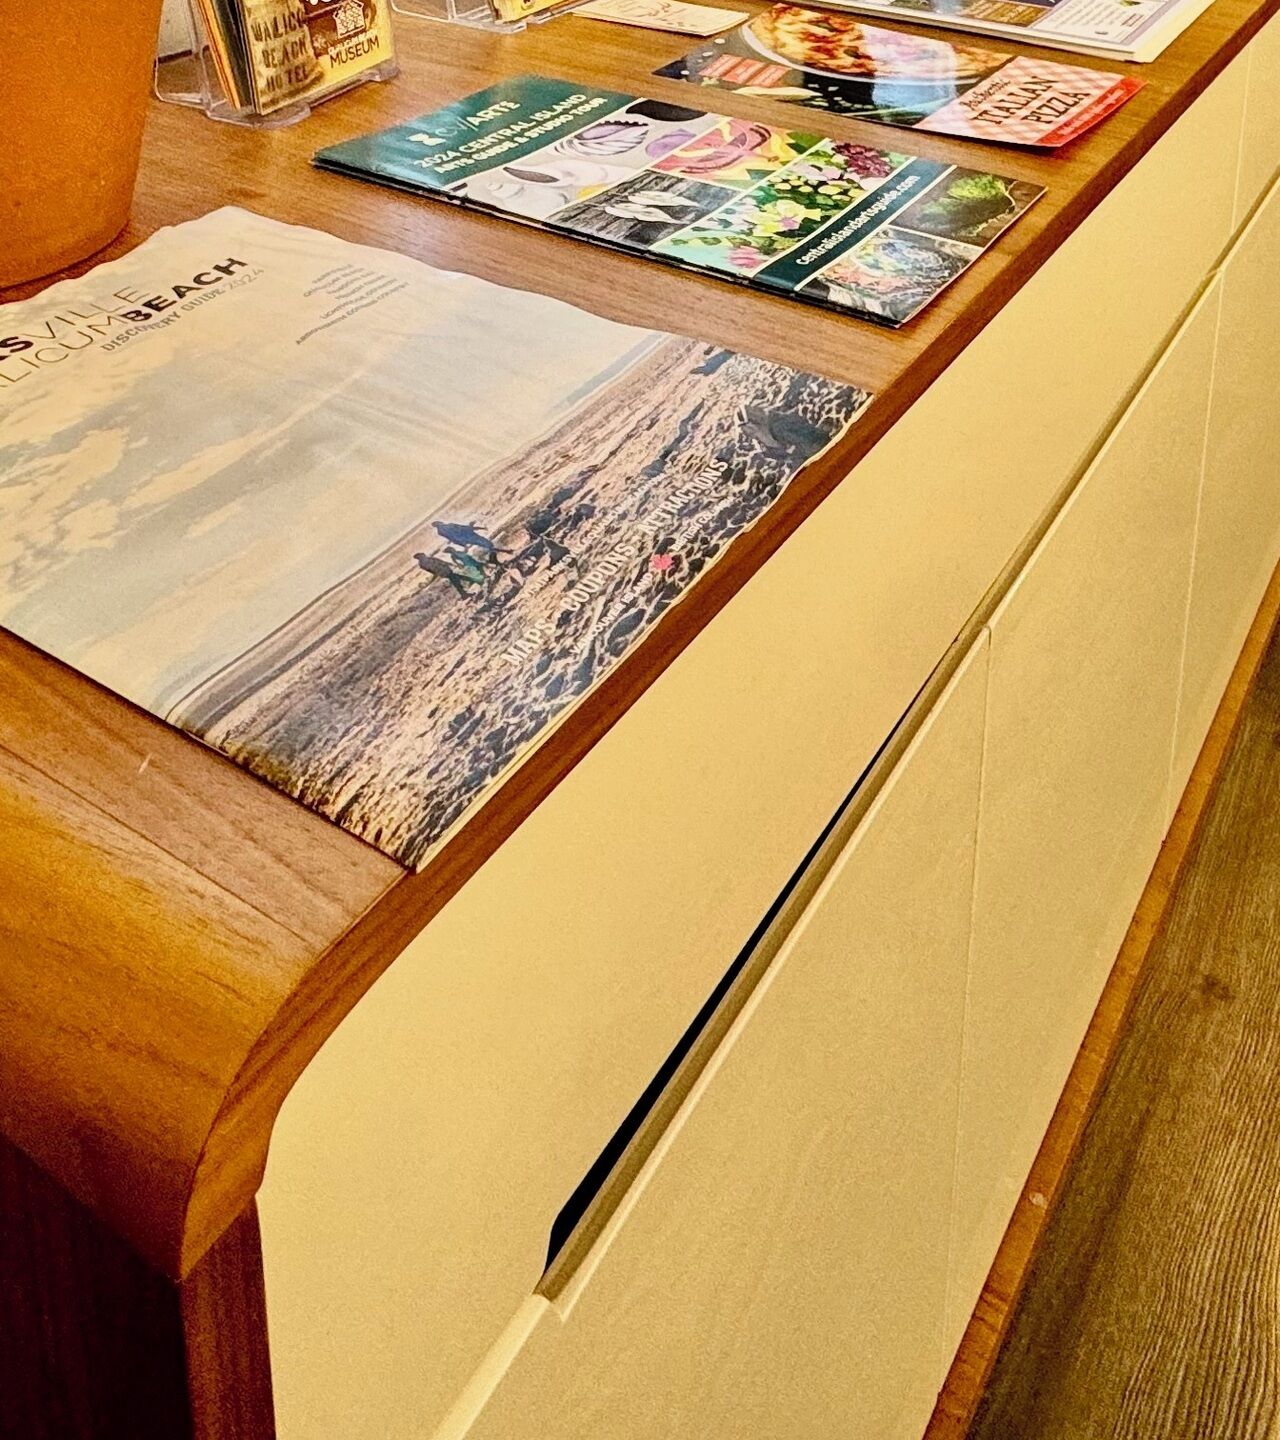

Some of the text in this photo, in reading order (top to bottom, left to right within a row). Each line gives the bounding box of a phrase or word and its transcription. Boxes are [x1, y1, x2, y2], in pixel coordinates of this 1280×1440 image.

[261, 38, 309, 69] BEACH
[329, 35, 380, 69] MUSEUM
[414, 93, 587, 168] 2024 CENTRAL ISLAND
[970, 75, 1060, 125] ITALIAN
[1020, 91, 1092, 125] PIZZA
[434, 156, 476, 174] ARTS
[471, 141, 519, 161] GUIDE
[526, 113, 574, 139] STUDIO
[570, 96, 609, 117] TOUR
[100, 311, 183, 352] DISCOVERY
[180, 287, 227, 312] GUIDE
[500, 458, 730, 666] MAPS COUPONS ATTRACTIONS
[569, 601, 627, 655] VANCOUVER
[620, 572, 654, 605] ISLAND
